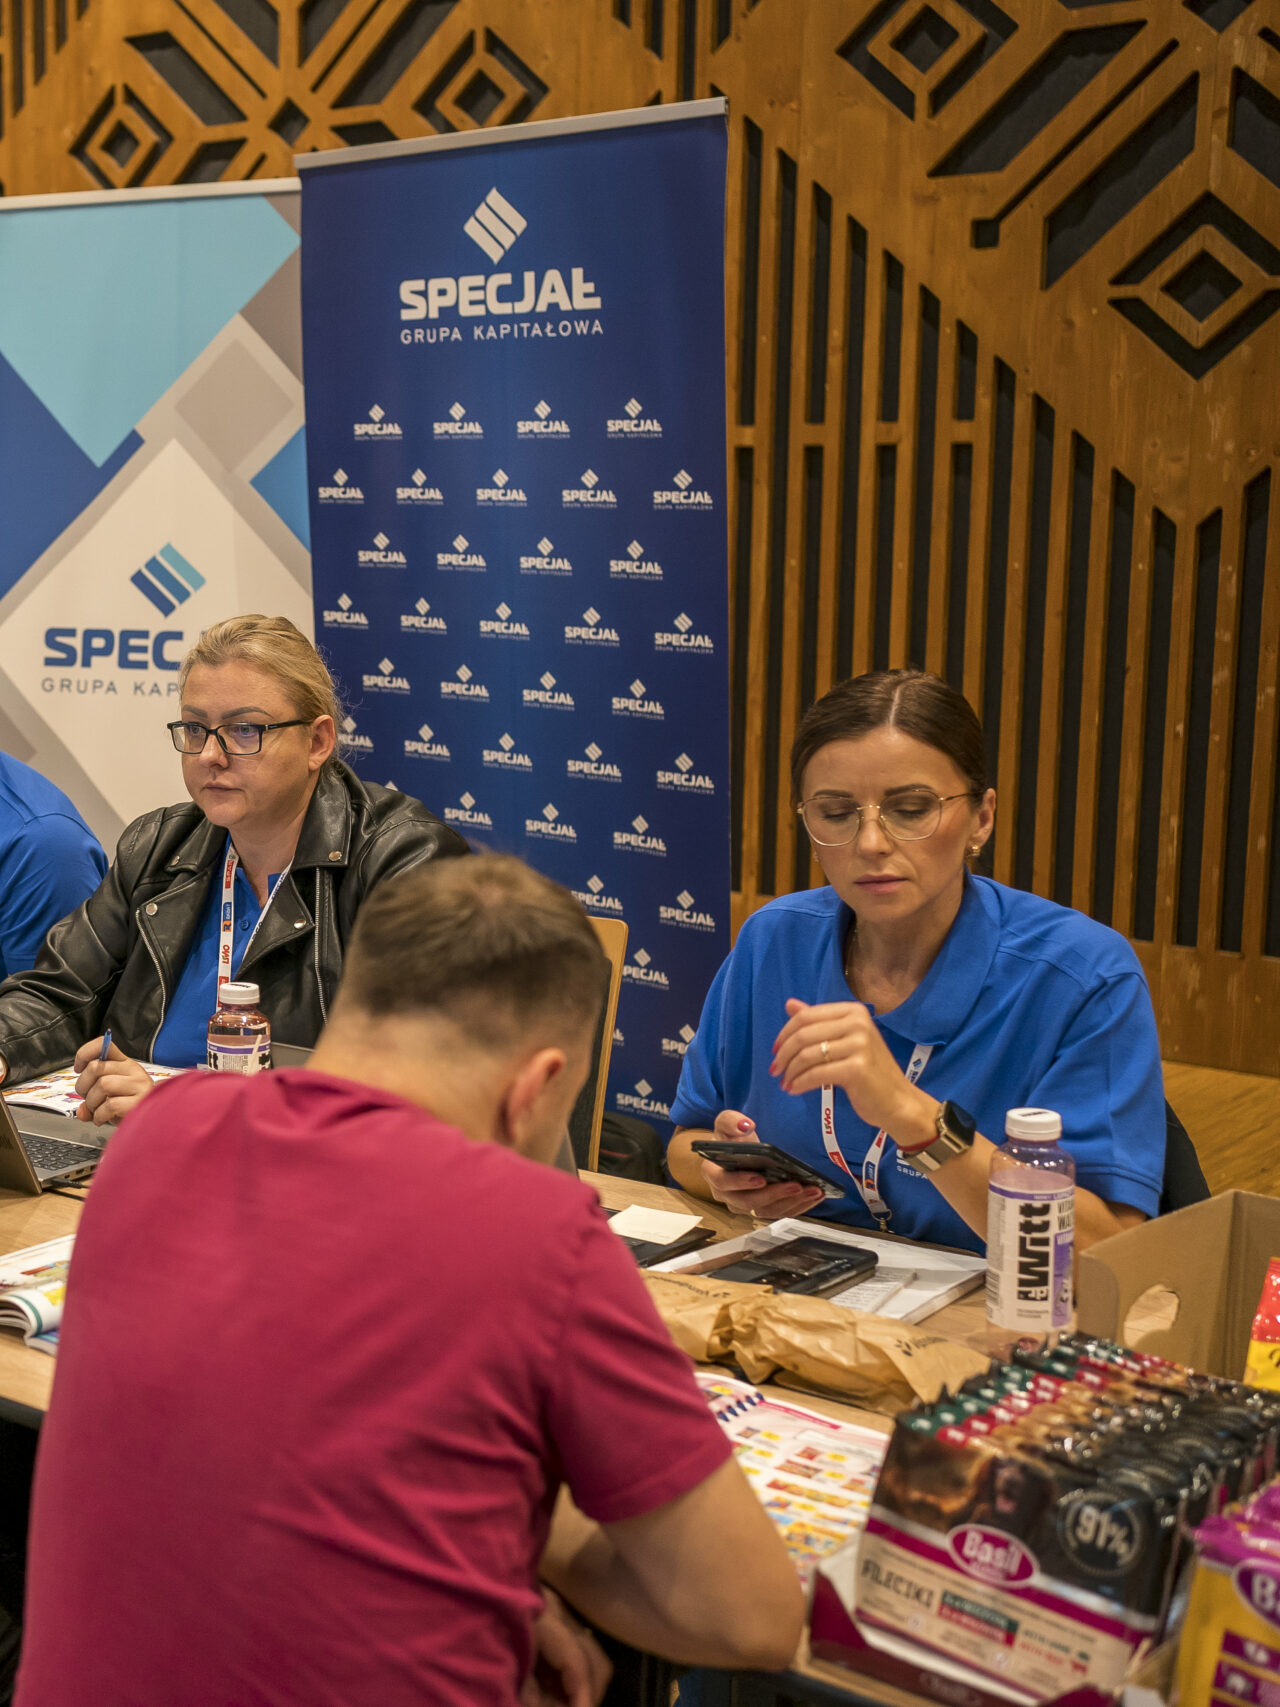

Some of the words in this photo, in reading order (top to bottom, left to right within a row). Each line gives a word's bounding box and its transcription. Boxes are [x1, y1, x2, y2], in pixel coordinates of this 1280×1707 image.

[400, 267, 602, 321] SPECJAŁ
[400, 325, 463, 345] GRUPA
[473, 319, 604, 341] KAPITAŁOWA
[517, 420, 570, 433] SPECJAŁ
[607, 419, 662, 432] SPECJAŁ
[477, 489, 527, 501] SPECJAŁ
[562, 490, 617, 502] SPECJAŁ
[654, 491, 713, 503] SPECJAŁ
[520, 557, 572, 570] SPECJAŁ
[610, 560, 663, 574] SPECJAŁ
[480, 620, 530, 635] SPECJAŁ
[565, 626, 619, 641] SPECJAŁ
[655, 632, 714, 648] SPECJAŁ
[43, 627, 184, 671] SPEC
[41, 677, 118, 695] GRUPA
[523, 689, 574, 705] SPECJAŁ
[612, 697, 664, 714] SPECJAŁ
[340, 733, 373, 748] ECJAŁ
[483, 750, 532, 766] SPECJAŁ
[568, 760, 622, 777] SPECJAŁ
[657, 771, 714, 788] SPECJAŁ
[526, 820, 577, 837] SPECJAŁ
[614, 832, 666, 851] SPECJAŁ
[660, 906, 715, 926] SPECJAŁ
[623, 966, 669, 985] PECJAŁ
[617, 1093, 670, 1115] SPECJAŁ
[896, 1165, 928, 1180] GRUPA
[1018, 1203, 1051, 1288] Witt
[1075, 1504, 1131, 1555] 91%
[962, 1529, 1023, 1577] Basil
